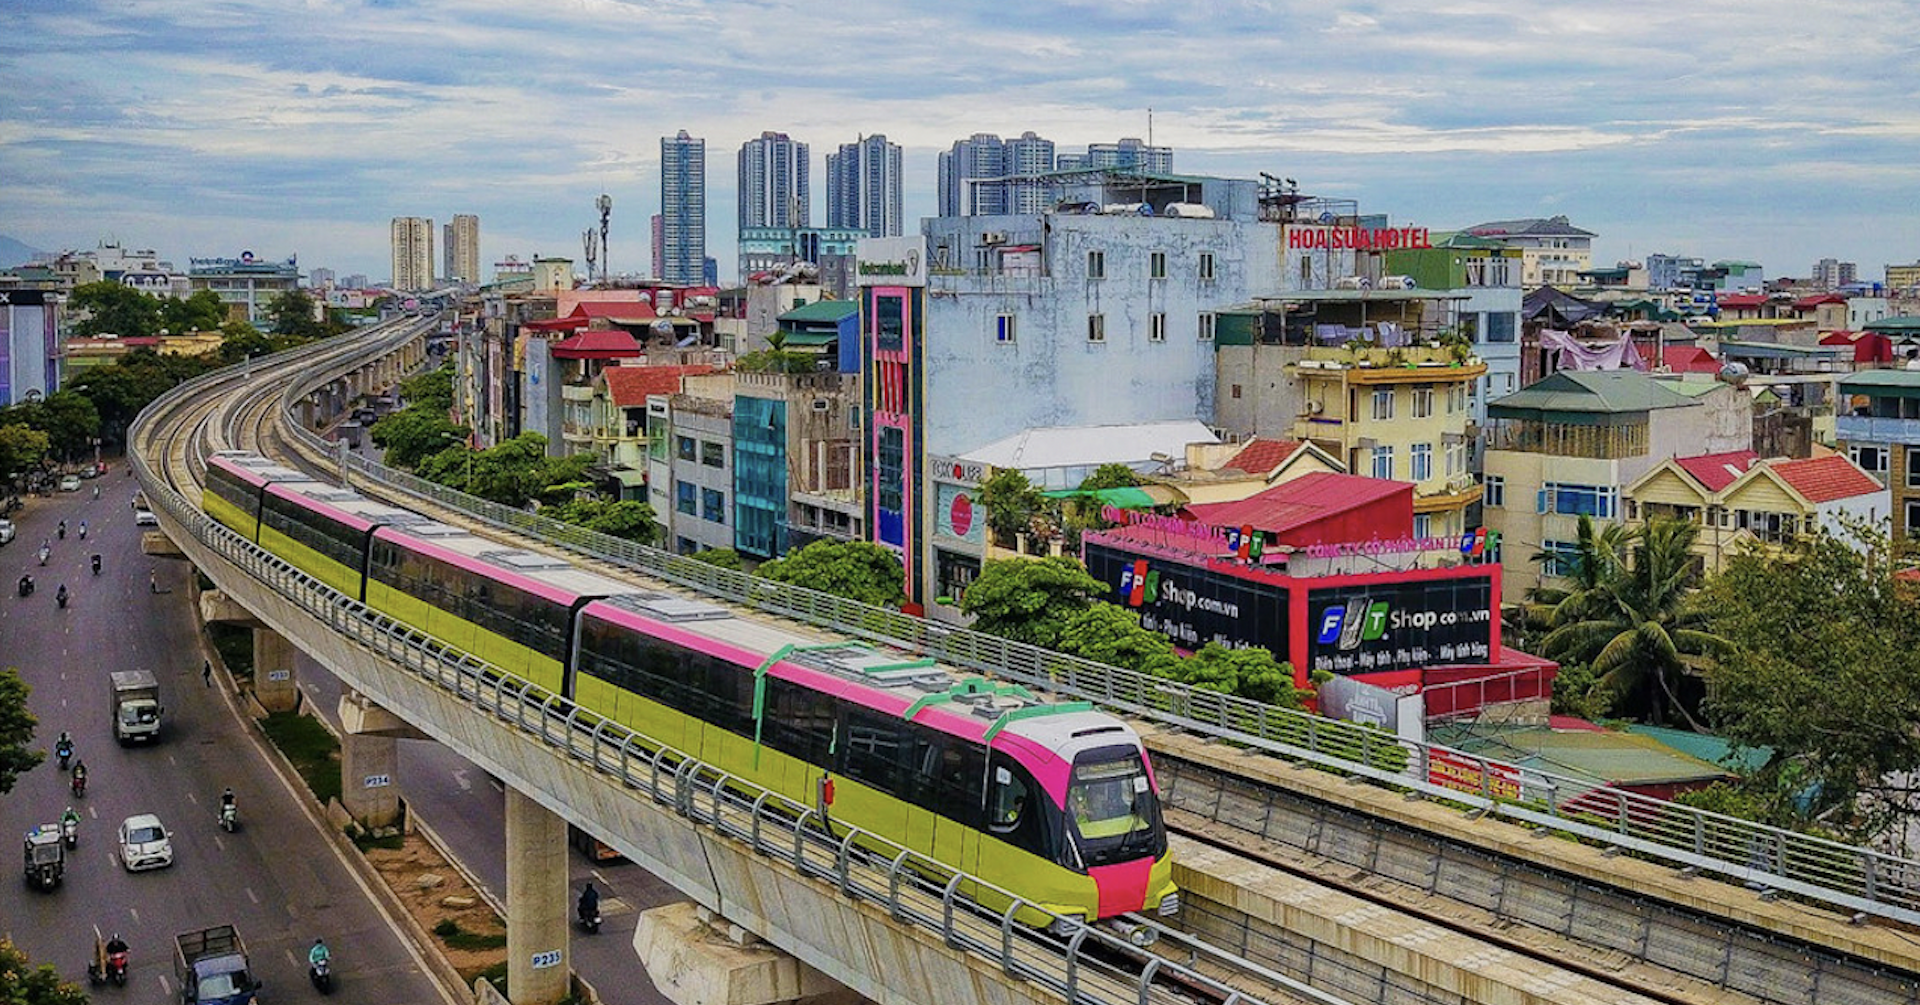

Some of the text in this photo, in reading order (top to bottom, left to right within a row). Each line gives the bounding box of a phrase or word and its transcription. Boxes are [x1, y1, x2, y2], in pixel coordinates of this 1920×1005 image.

[1290, 229, 1328, 249] HOA
[1373, 228, 1432, 249] HOTEL
[1228, 528, 1261, 554] FPT
[1461, 530, 1497, 551] FPT
[1390, 609, 1438, 632] Shop
[533, 952, 560, 965] P235
